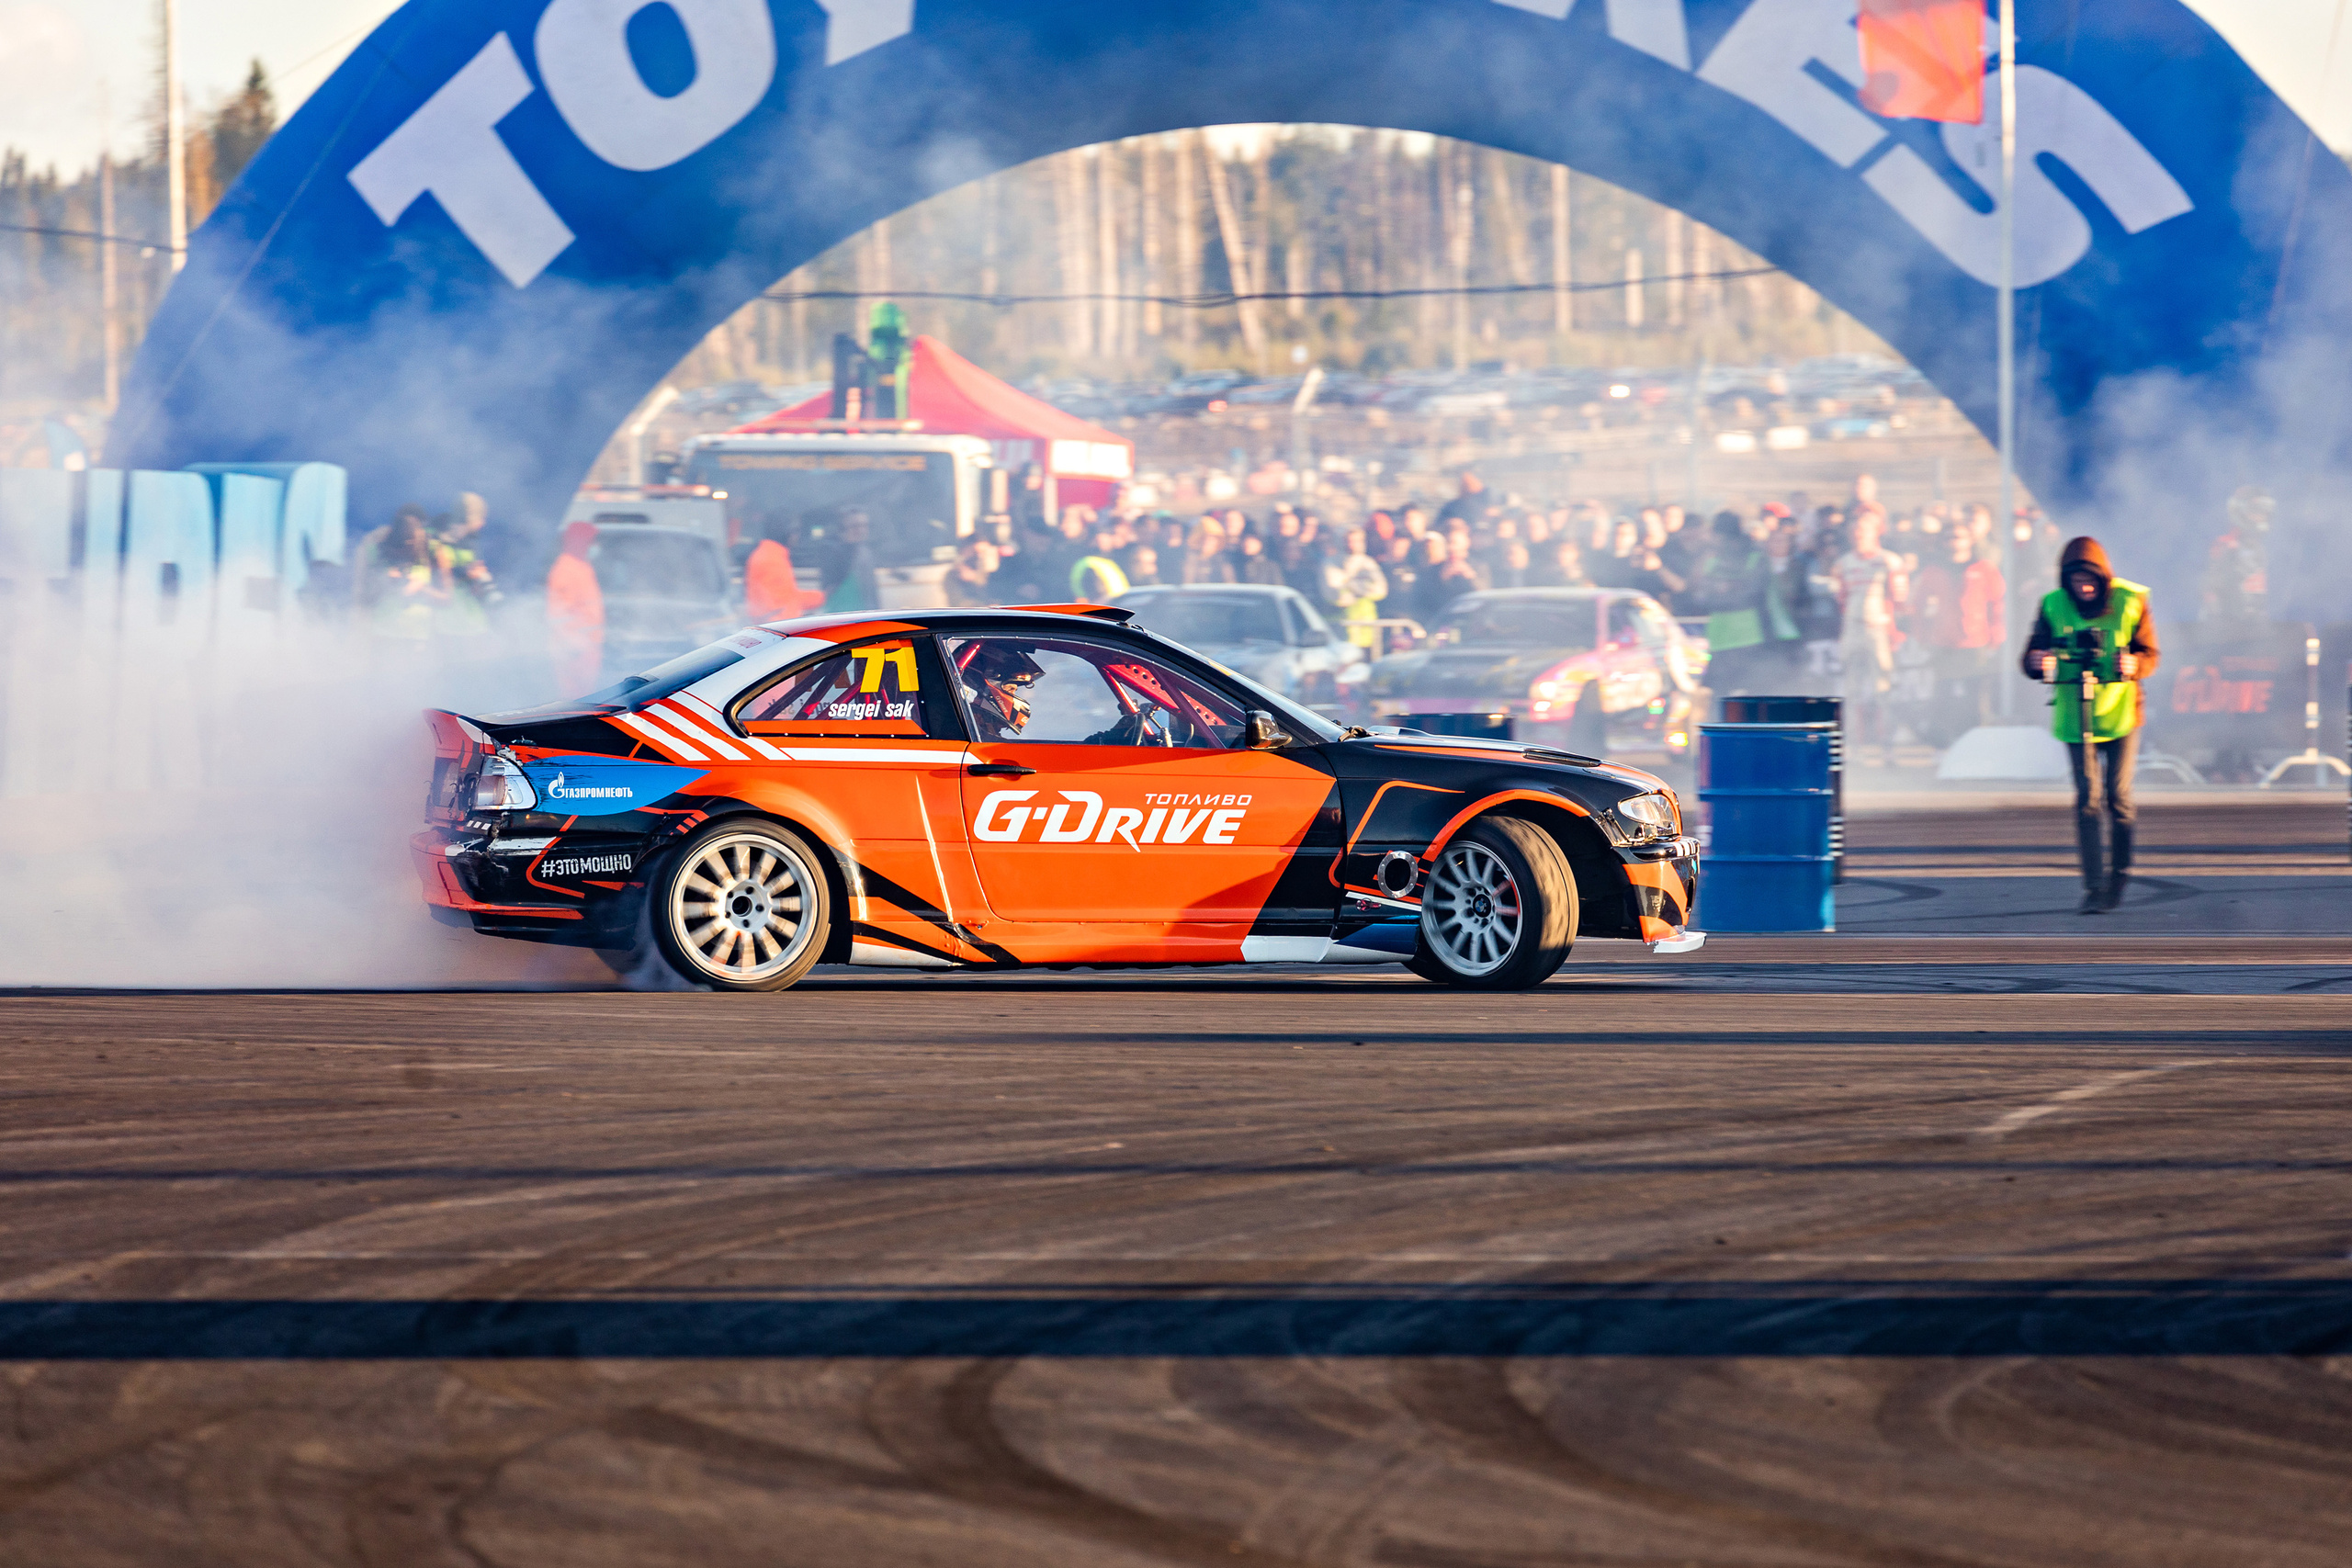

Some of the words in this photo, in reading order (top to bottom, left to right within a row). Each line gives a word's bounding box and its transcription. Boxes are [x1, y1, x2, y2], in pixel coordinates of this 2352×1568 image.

[1490, 0, 2195, 289] ES
[851, 646, 920, 694] 71
[828, 700, 882, 720] sergei
[885, 699, 915, 717] sak
[564, 786, 634, 799] ГАЗПРОМНЕФТЬ
[1145, 793, 1253, 807] ТОПЛИВО
